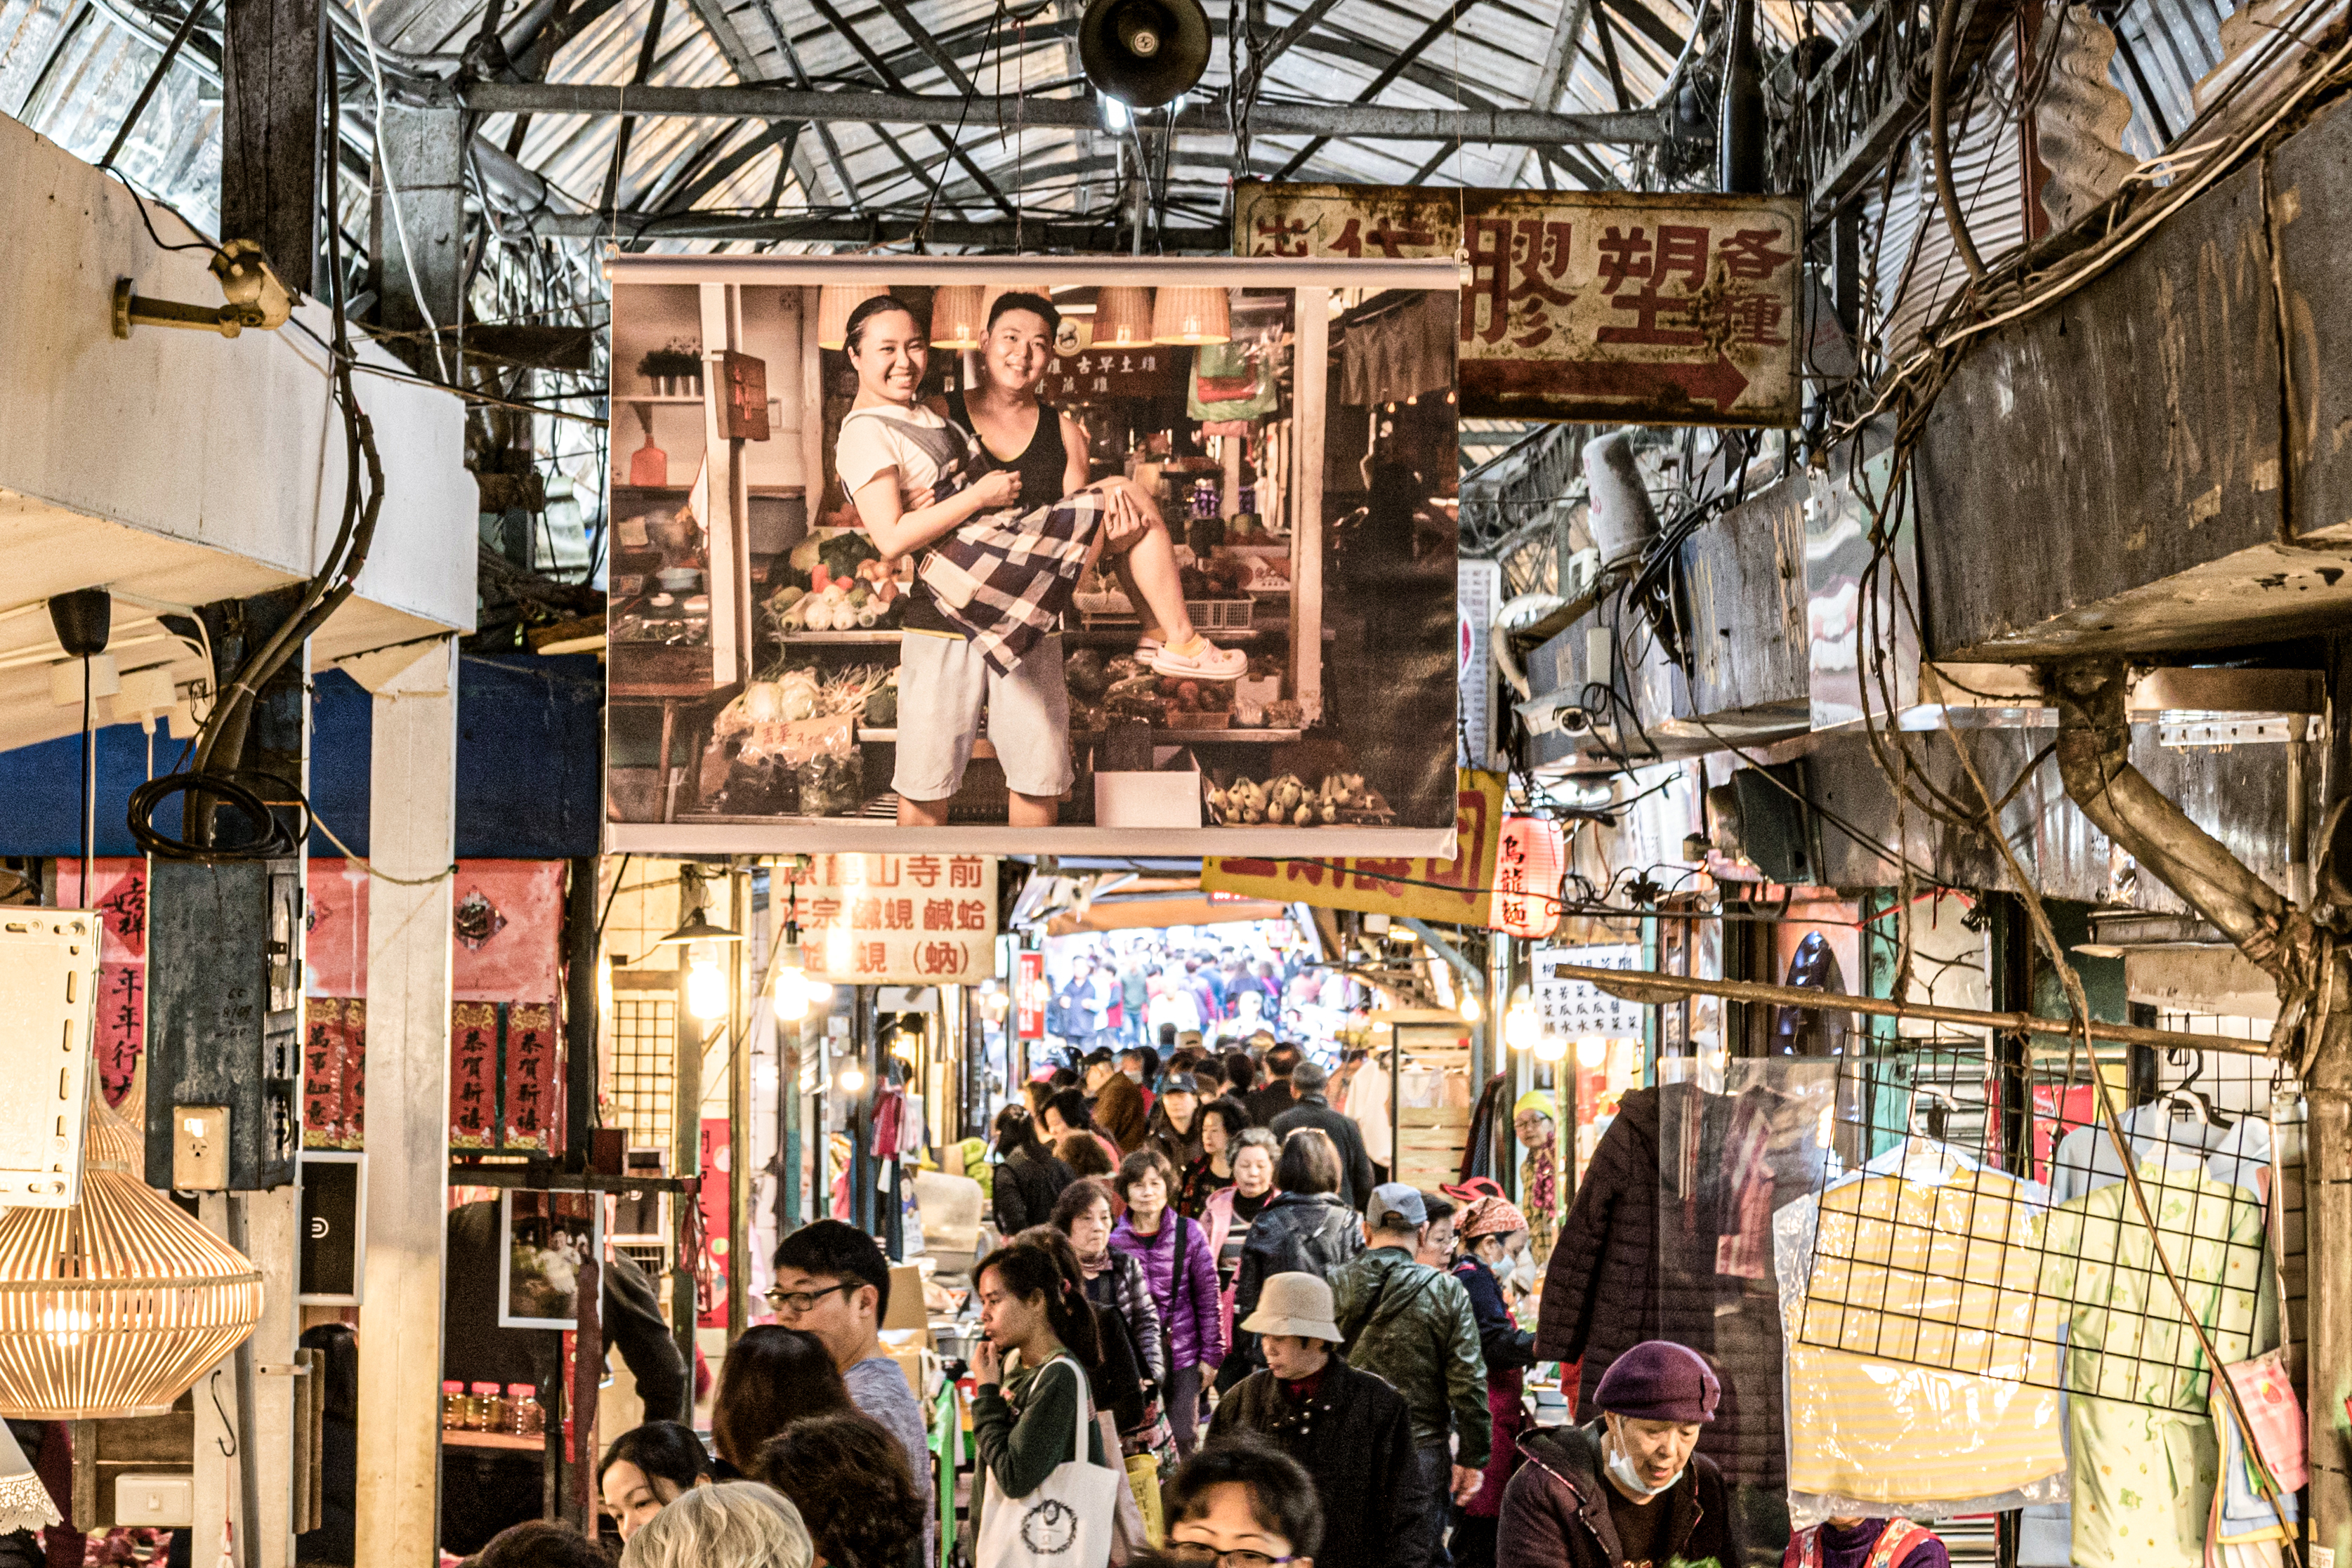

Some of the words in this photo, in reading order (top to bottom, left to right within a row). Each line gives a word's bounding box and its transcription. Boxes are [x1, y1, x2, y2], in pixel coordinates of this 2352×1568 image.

[459, 1030, 487, 1130] 恭賀新禧
[516, 1032, 544, 1131] 恭賀新禧
